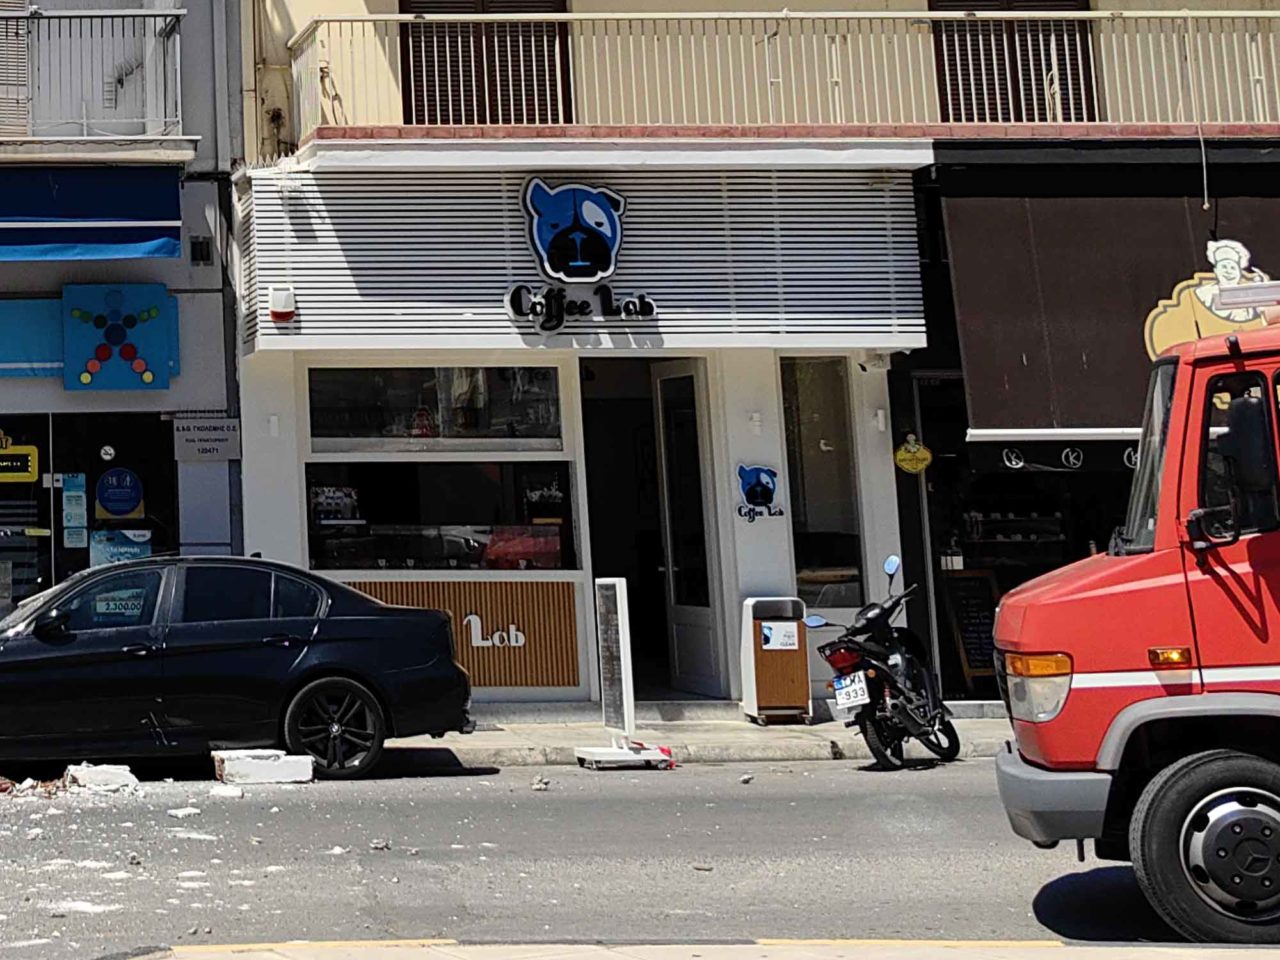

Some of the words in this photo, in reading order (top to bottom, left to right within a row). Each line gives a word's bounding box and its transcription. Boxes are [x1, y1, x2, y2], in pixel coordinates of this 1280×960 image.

[510, 284, 593, 331] Coffee
[593, 284, 655, 317] Lab
[463, 614, 525, 647] Lab
